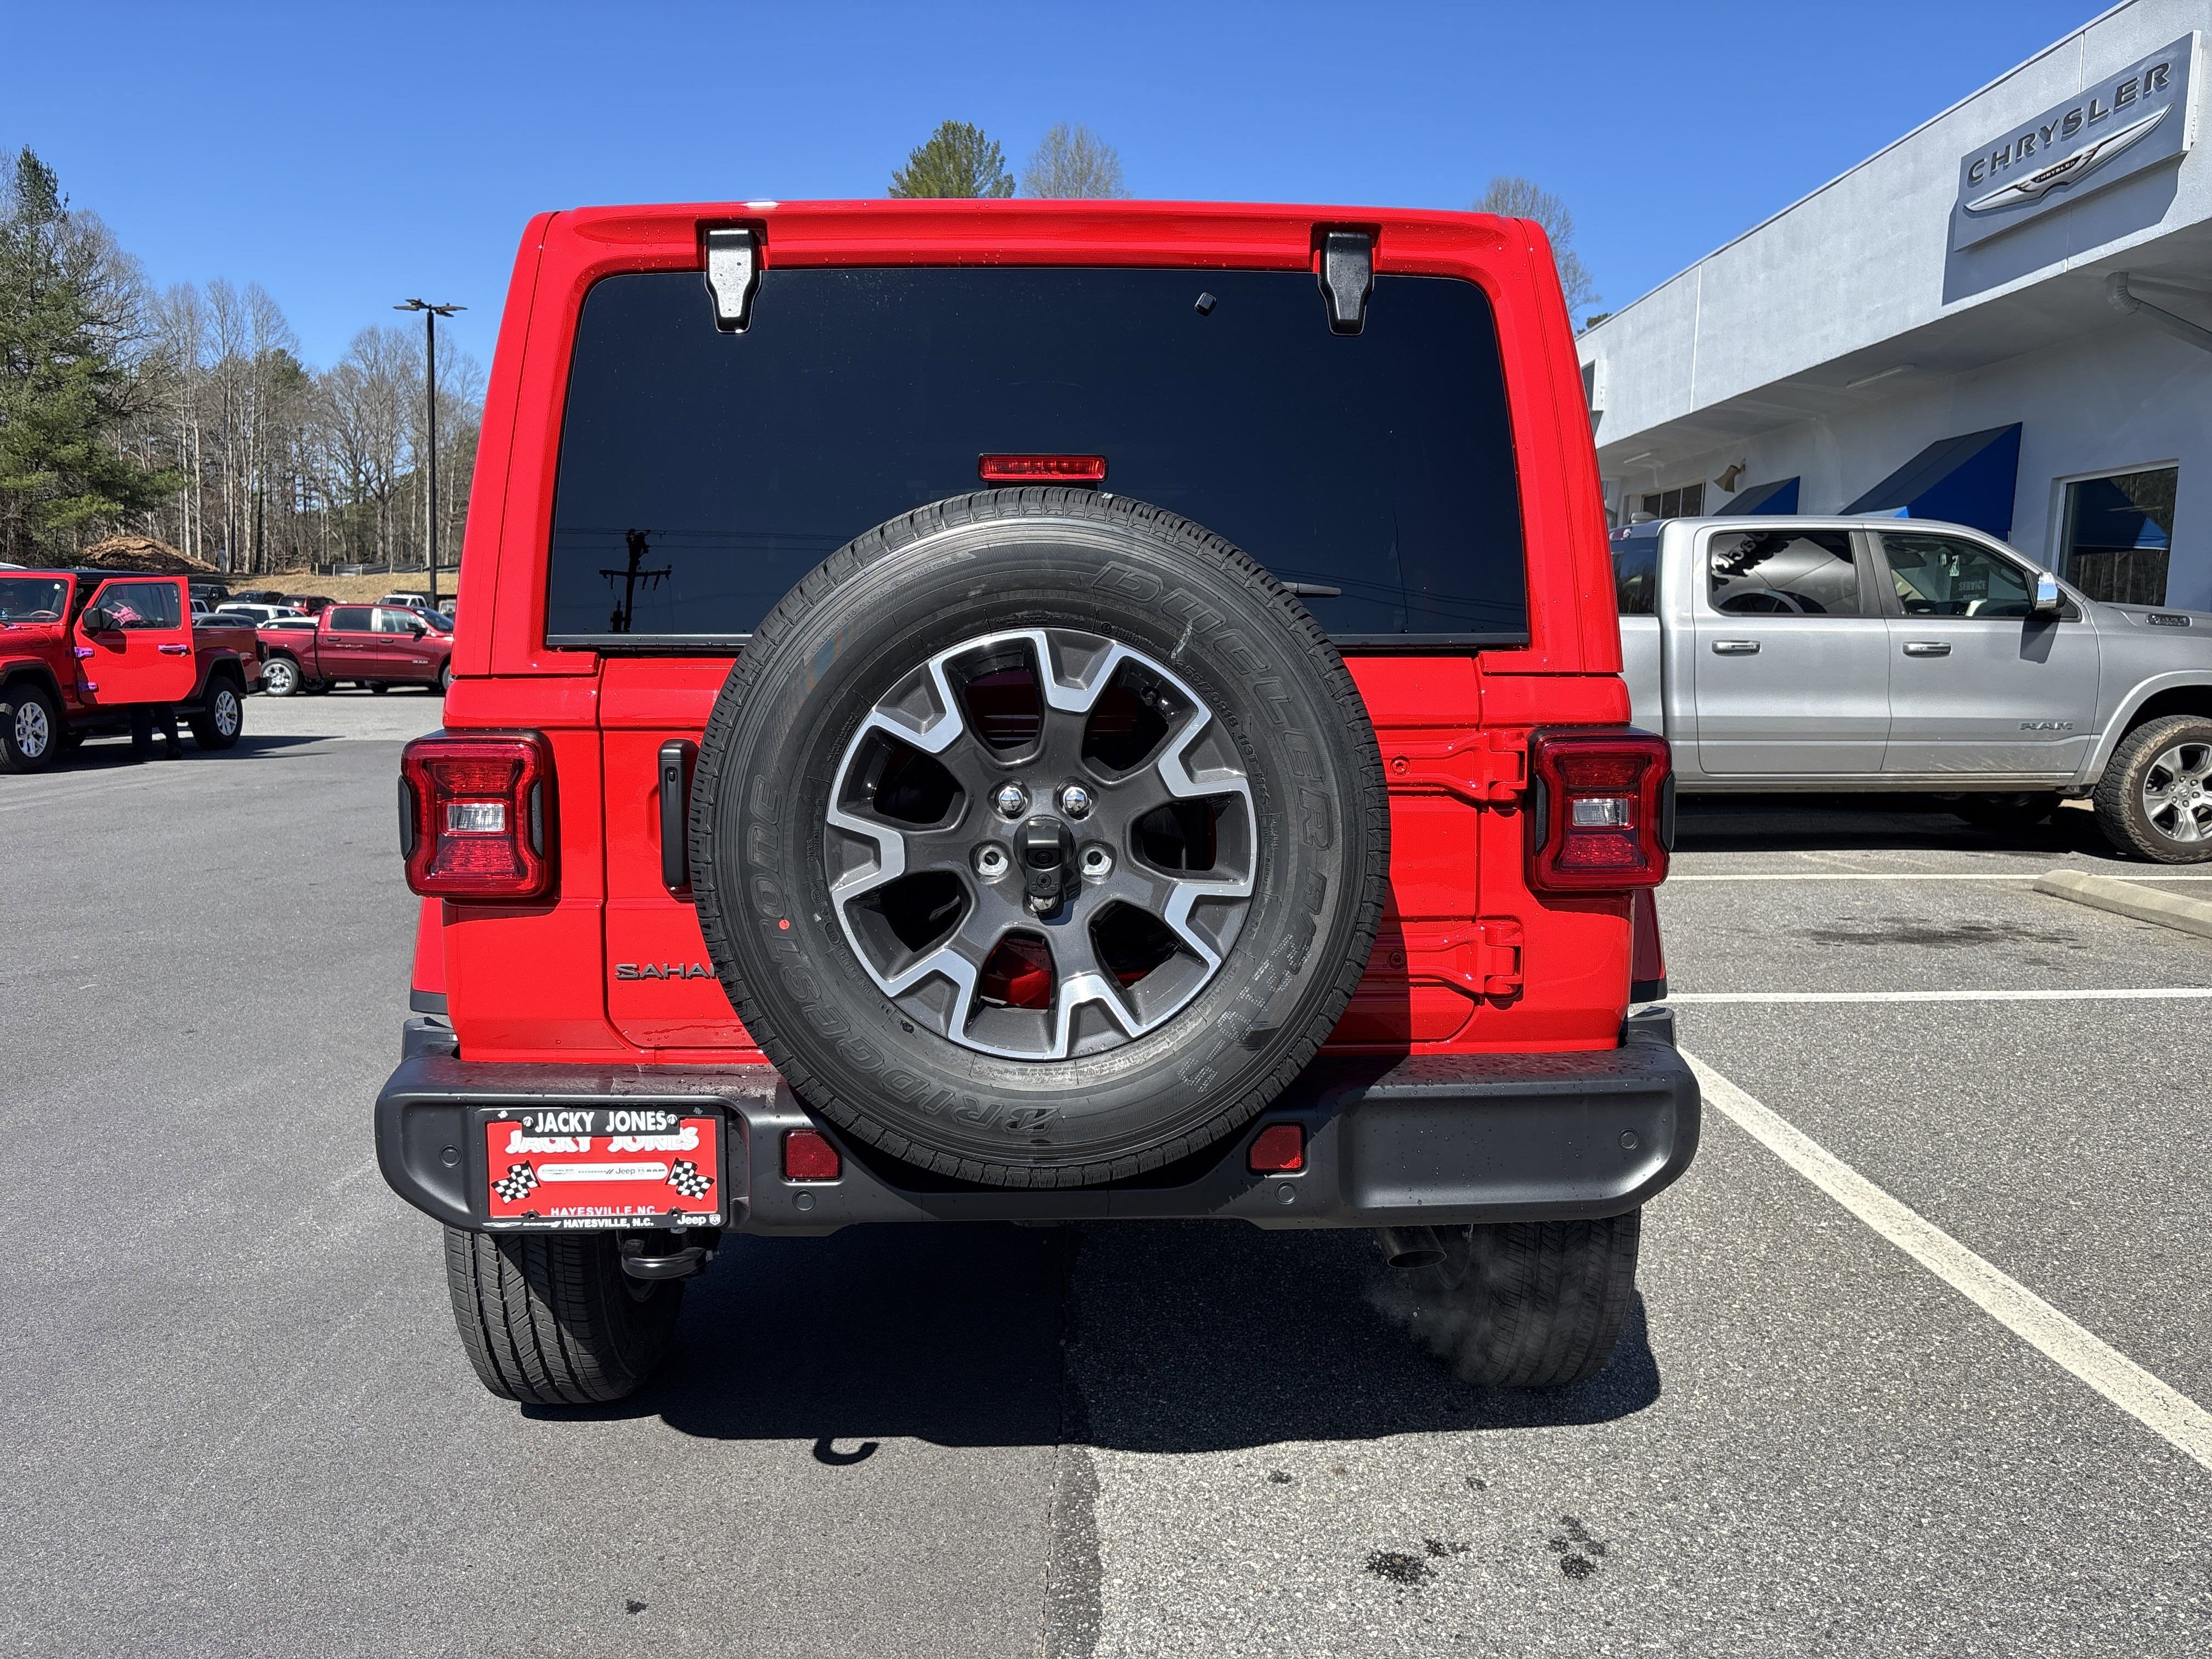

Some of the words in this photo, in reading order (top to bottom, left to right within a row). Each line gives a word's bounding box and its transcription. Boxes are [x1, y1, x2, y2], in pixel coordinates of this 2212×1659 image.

[1967, 62, 2171, 182] CHRYSLER
[1091, 560, 1334, 850] DUELER
[1175, 659, 1239, 727] 255/70R18
[1237, 731, 1260, 766] 113T
[2019, 721, 2073, 730] RAM
[748, 774, 1063, 1136] BRIDGESTONE
[505, 1130, 592, 1154] JACKY
[607, 1127, 699, 1153] JONES
[535, 1111, 595, 1133] JACKY
[605, 1110, 668, 1132] JONES
[563, 1218, 630, 1228] HAYESVILLE,
[632, 1217, 654, 1227] N.C.
[677, 1215, 707, 1226] Jeep
